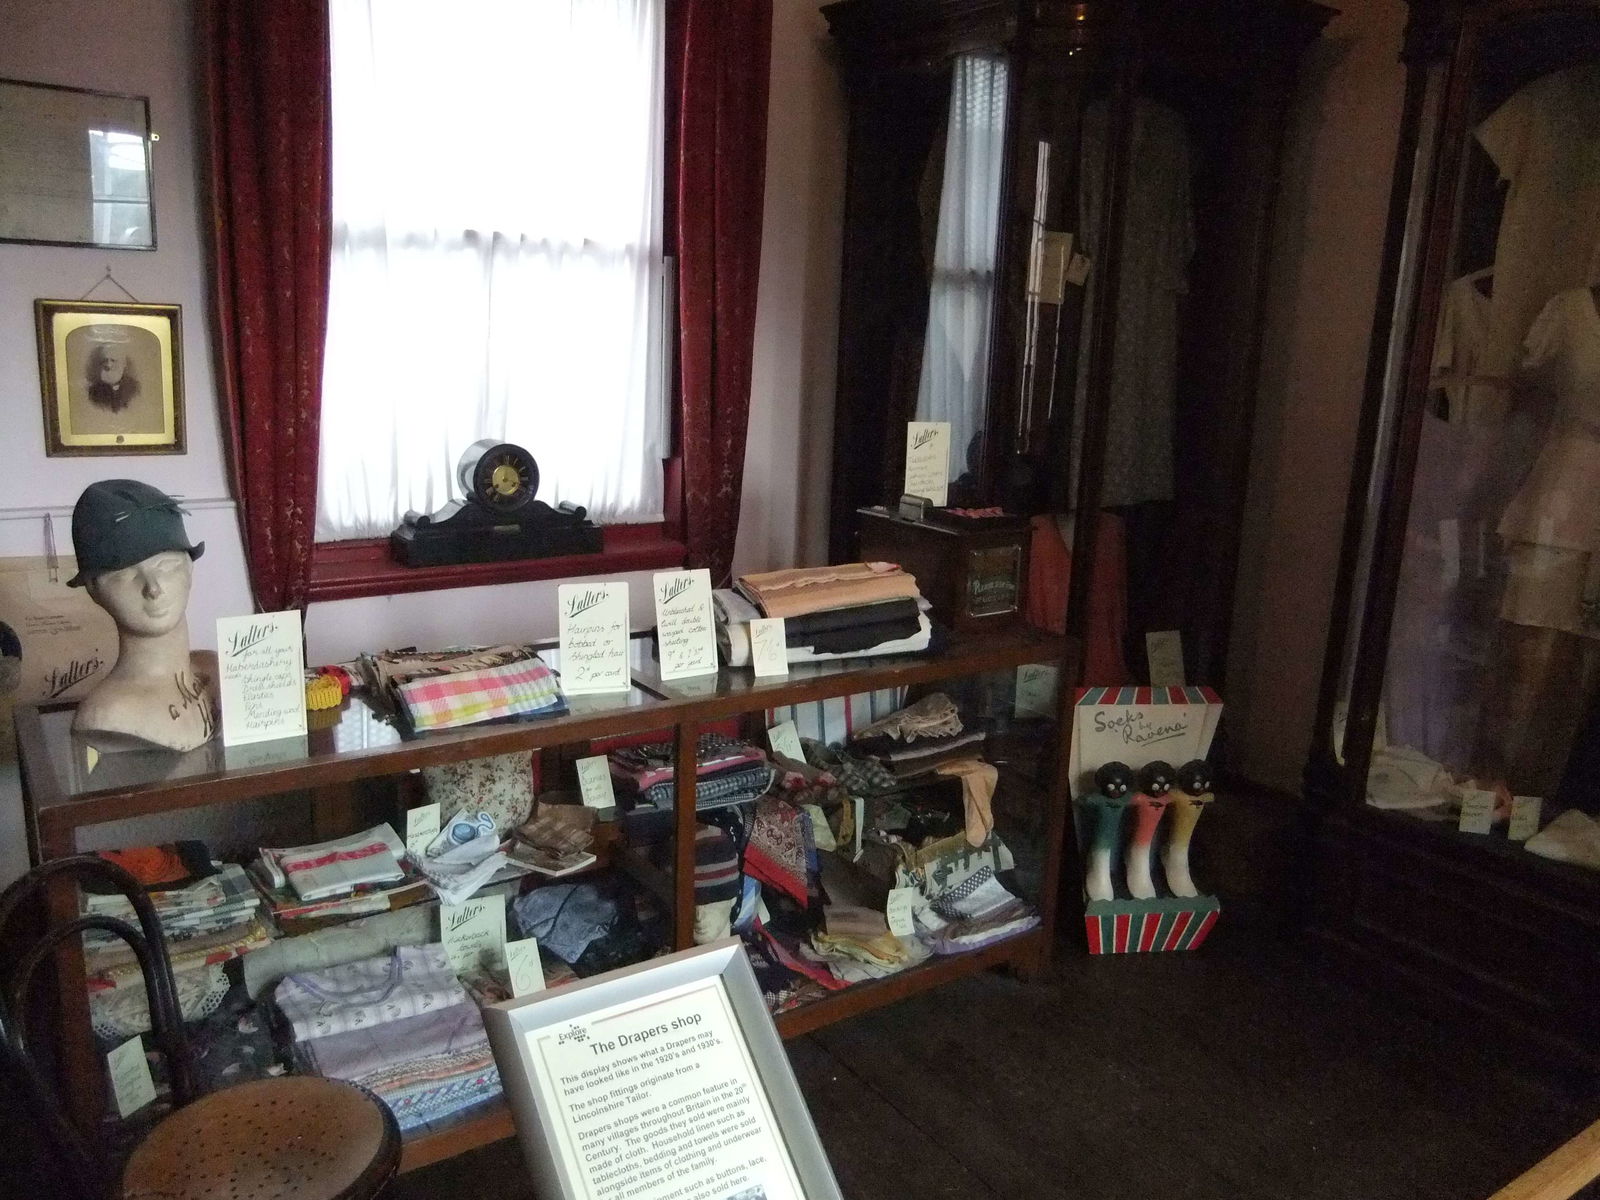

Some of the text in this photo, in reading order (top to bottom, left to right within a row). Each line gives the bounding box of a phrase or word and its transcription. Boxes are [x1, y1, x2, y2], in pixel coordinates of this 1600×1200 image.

[1095, 709, 1144, 732] Socks
[559, 1027, 587, 1041] Explore
[560, 1074, 580, 1085] This
[581, 1064, 610, 1079] display
[612, 1055, 638, 1068] shows
[639, 1047, 659, 1059] what
[666, 1036, 697, 1050] Drapers
[697, 1030, 713, 1040] may
[590, 1013, 702, 1055] The Drapers shop
[564, 1084, 585, 1096] have
[585, 1073, 614, 1089] looked
[615, 1069, 630, 1079] like
[631, 1065, 640, 1073] in
[641, 1060, 654, 1070] the
[681, 1045, 696, 1056] and
[568, 1102, 586, 1112] The
[587, 1094, 609, 1107] shop
[609, 1084, 639, 1098] fittings
[640, 1071, 674, 1088] originate
[675, 1064, 694, 1075] from
[572, 1091, 652, 1124] Lincolnshire Tailor.
[578, 1123, 612, 1141] Drapers
[613, 1113, 639, 1128] shops
[640, 1106, 660, 1117] were
[668, 1091, 702, 1107] common
[702, 1081, 729, 1095] feature
[582, 1138, 605, 1151] many
[607, 1126, 639, 1142] villages
[640, 1108, 685, 1129] throughout
[685, 1098, 712, 1112] Britain
[721, 1090, 734, 1100] the
[624, 1137, 641, 1147] The
[642, 1126, 669, 1142] goods
[669, 1119, 687, 1131] they
[688, 1111, 706, 1123] sold
[706, 1105, 725, 1117] were
[725, 1096, 750, 1110] mainly
[589, 1160, 613, 1174] made
[615, 1153, 624, 1164] of
[651, 1126, 695, 1149] Household
[695, 1120, 716, 1132] linen
[717, 1112, 735, 1125] such
[736, 1109, 746, 1118] as
[596, 1175, 639, 1196] alongside
[639, 1165, 663, 1179] items
[664, 1159, 673, 1169] of
[674, 1149, 707, 1165] clothing
[707, 1140, 722, 1152] and
[723, 1127, 762, 1146] underwear
[643, 1148, 677, 1165] bedding
[678, 1139, 693, 1152] and
[693, 1130, 720, 1145] towels
[720, 1124, 739, 1135] were
[740, 1115, 757, 1128] sold
[614, 1191, 625, 1200] all
[626, 1176, 666, 1197] members
[667, 1171, 675, 1181] of
[676, 1166, 690, 1177] the
[684, 1180, 704, 1193] such
[706, 1175, 715, 1185] as
[694, 1190, 710, 1200] also
[712, 1182, 729, 1195] sold
